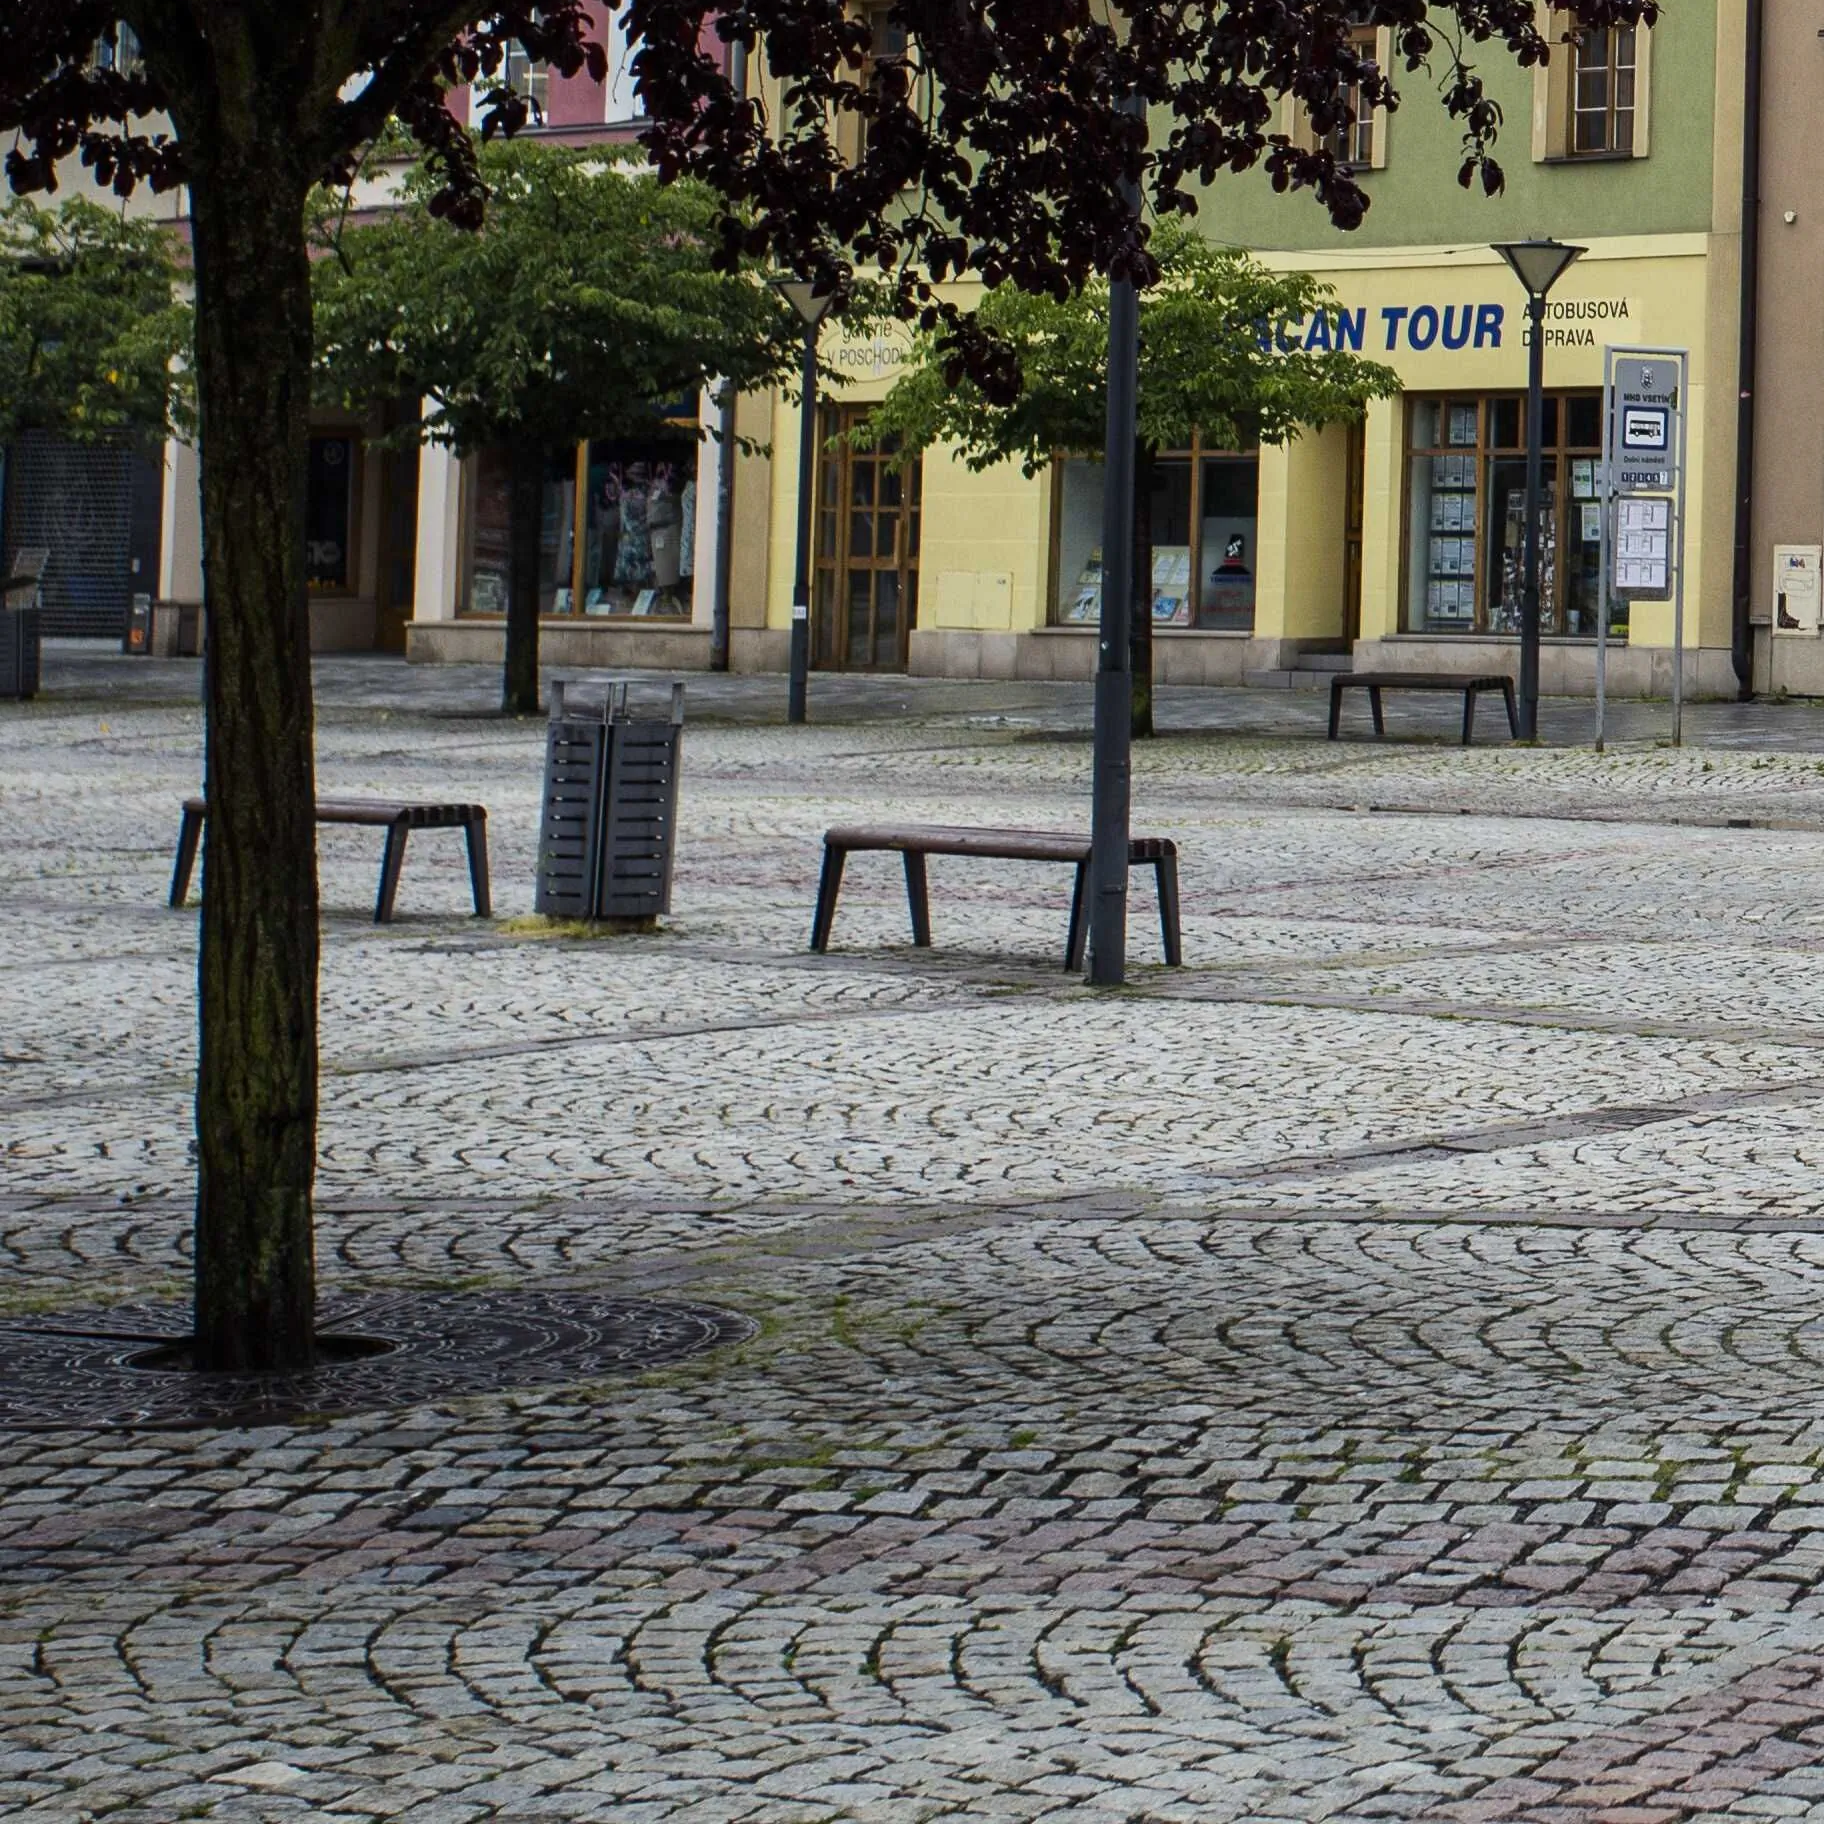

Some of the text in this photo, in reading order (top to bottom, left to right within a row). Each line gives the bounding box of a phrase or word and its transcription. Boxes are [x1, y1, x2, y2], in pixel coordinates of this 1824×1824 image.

[1522, 297, 1629, 320] ATOBUSOVÁ
[1381, 303, 1505, 351] TOUR
[1522, 329, 1595, 347] DPRAVA
